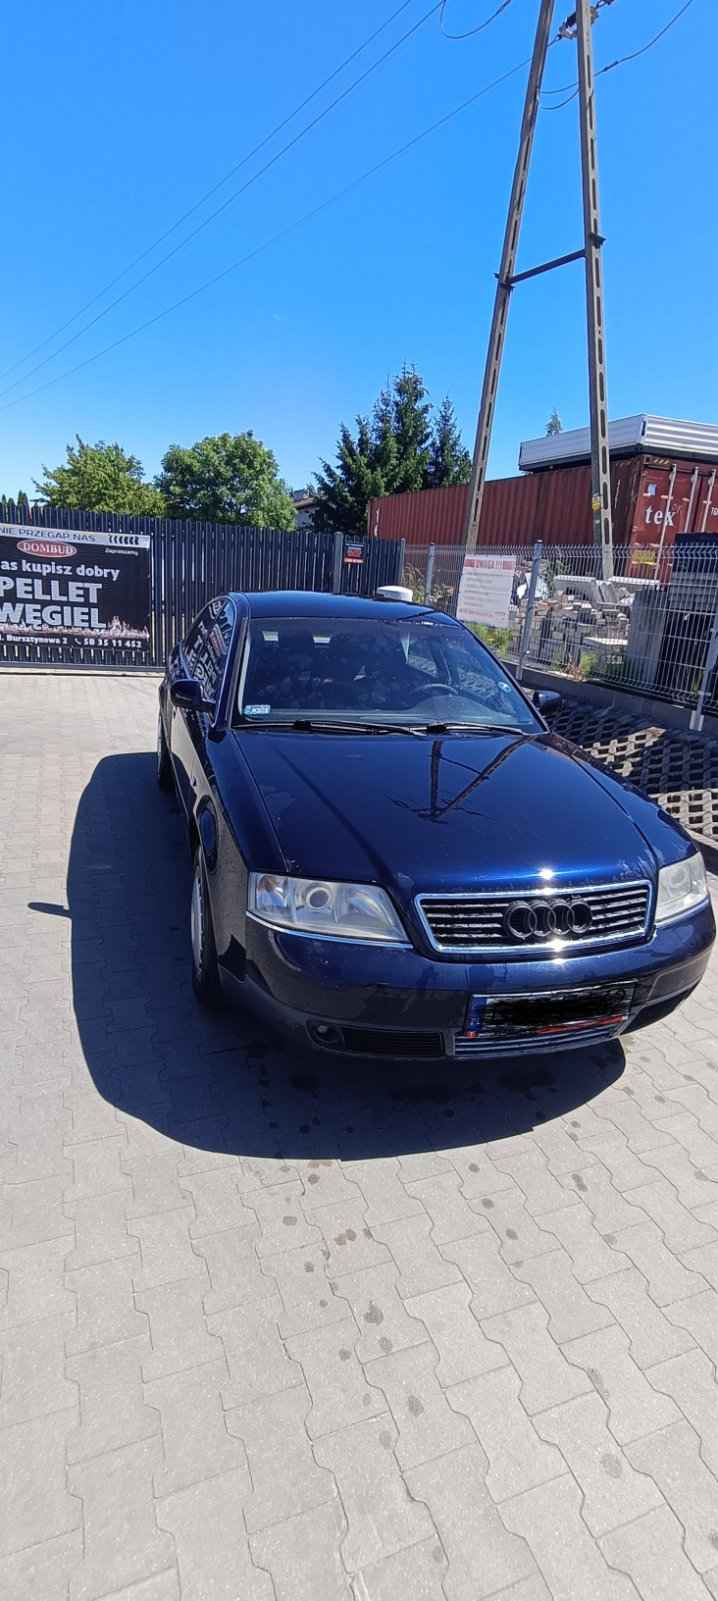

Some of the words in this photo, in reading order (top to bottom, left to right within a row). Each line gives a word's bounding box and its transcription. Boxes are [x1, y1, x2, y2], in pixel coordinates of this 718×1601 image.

[73, 534, 96, 543] NAS
[23, 542, 75, 555] DOMBUD
[22, 560, 73, 576] kupisz
[76, 564, 120, 582] dobry
[0, 576, 102, 603] PELLET
[0, 602, 106, 631] WĘGIEL
[112, 639, 122, 647] 11
